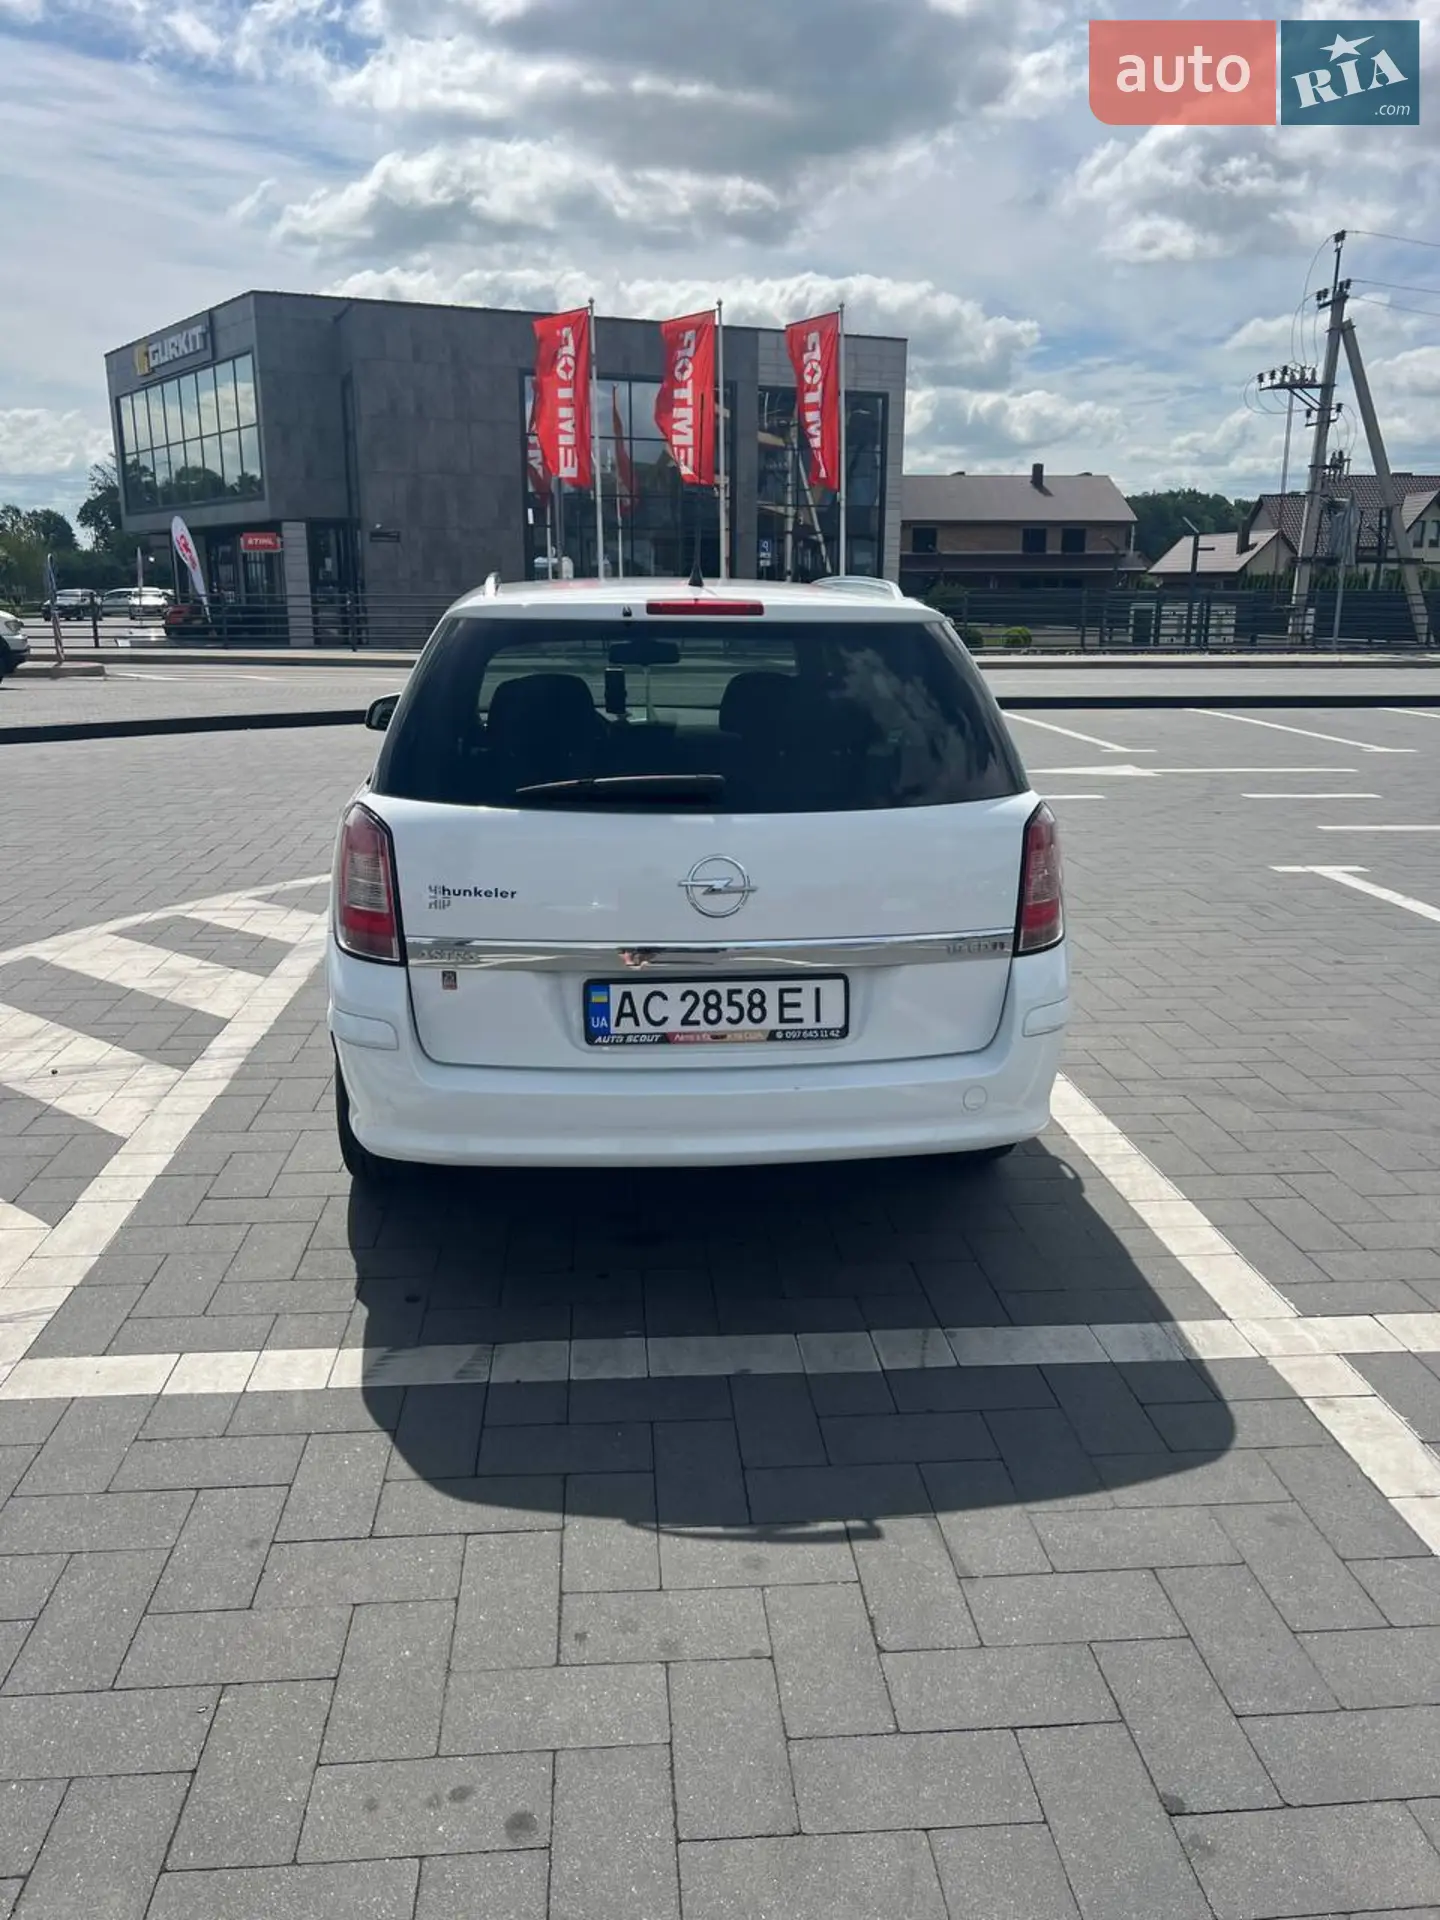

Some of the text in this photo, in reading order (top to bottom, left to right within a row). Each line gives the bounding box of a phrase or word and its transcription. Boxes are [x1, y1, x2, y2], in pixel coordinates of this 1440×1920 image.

[148, 324, 208, 368] GURKIT
[441, 885, 517, 899] hunkeler
[614, 987, 821, 1028] AC 2858 EI
[591, 1017, 608, 1029] UA
[594, 1034, 661, 1044] AUTO SCOUT
